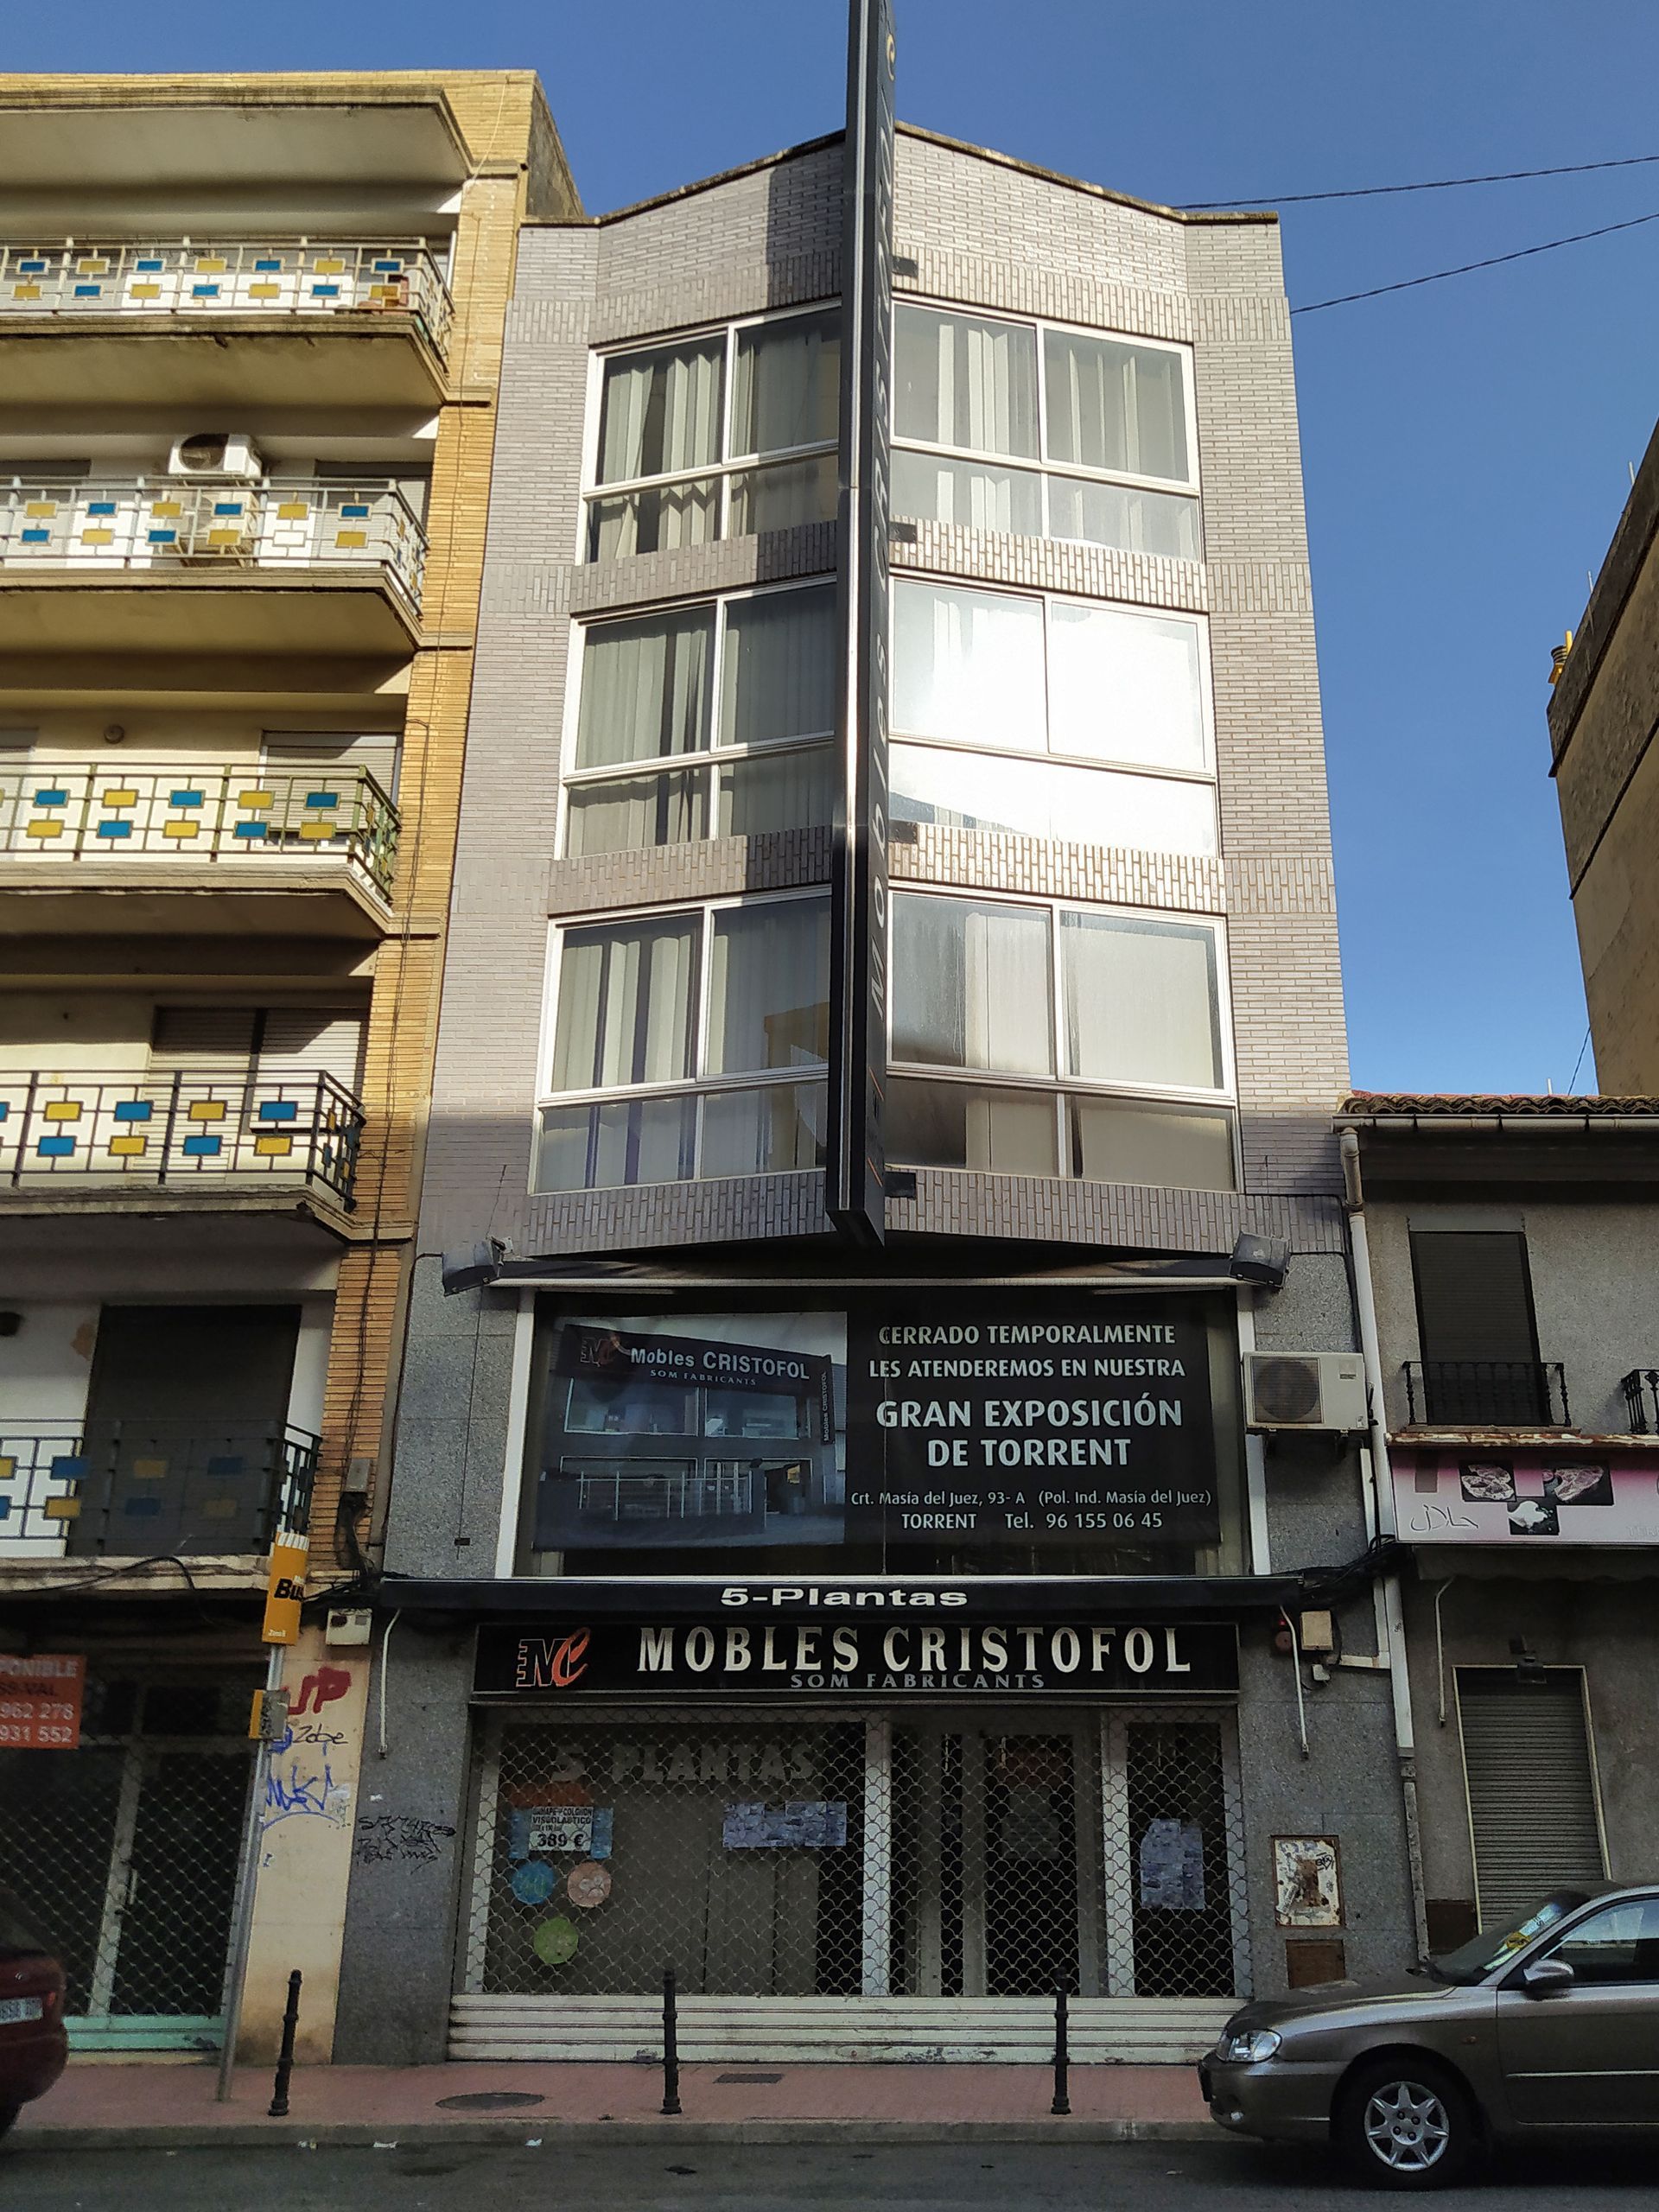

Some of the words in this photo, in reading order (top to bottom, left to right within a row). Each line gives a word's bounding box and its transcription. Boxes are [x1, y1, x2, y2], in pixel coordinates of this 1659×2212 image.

[874, 85, 893, 593] CRISTOFOL
[871, 632, 887, 1021] Mobles
[879, 1325, 979, 1344] CERRADO
[987, 1325, 1175, 1344] TEMPORALMENTE
[631, 1348, 695, 1367] Mobles
[702, 1351, 810, 1380] CRISTOFOL
[869, 1360, 901, 1378] LES
[907, 1359, 1054, 1377] ATENDEREMOS
[1061, 1359, 1087, 1376] EN
[1094, 1358, 1185, 1376] NUESTRA
[650, 1370, 677, 1379] SOM
[683, 1372, 756, 1386] FABRICANTS
[876, 1401, 971, 1427] GRAN
[984, 1392, 1182, 1427] EXPOSICIÓN
[928, 1440, 969, 1467] DE
[980, 1439, 1131, 1466] TORRENT
[851, 1492, 874, 1505] Crt.
[880, 1491, 919, 1505] Masía
[924, 1491, 945, 1504] del
[950, 1492, 982, 1508] Juez,
[988, 1492, 1011, 1504] 93-
[1015, 1492, 1026, 1504] A
[1039, 1490, 1070, 1507] (Pol.
[1075, 1490, 1101, 1503] Ind.
[1106, 1490, 1146, 1503] Masía
[1151, 1490, 1172, 1503] del
[1176, 1490, 1211, 1507] Juez)
[901, 1513, 977, 1529] TORRENT
[1005, 1512, 1034, 1529] Tel.
[1046, 1513, 1068, 1529] 96
[1075, 1513, 1107, 1529] 155
[1113, 1513, 1135, 1528] 06
[1141, 1512, 1162, 1528] 45
[721, 1587, 968, 1606] 5-Plantas
[636, 1626, 859, 1673] MOBLES
[882, 1626, 1192, 1674] CRISTOFOL
[790, 1674, 849, 1688] SOM
[867, 1674, 1046, 1689] FABRICANTS
[612, 1743, 814, 1782] PLANTAS
[537, 1833, 568, 1847] 389
[574, 1833, 585, 1847] €
